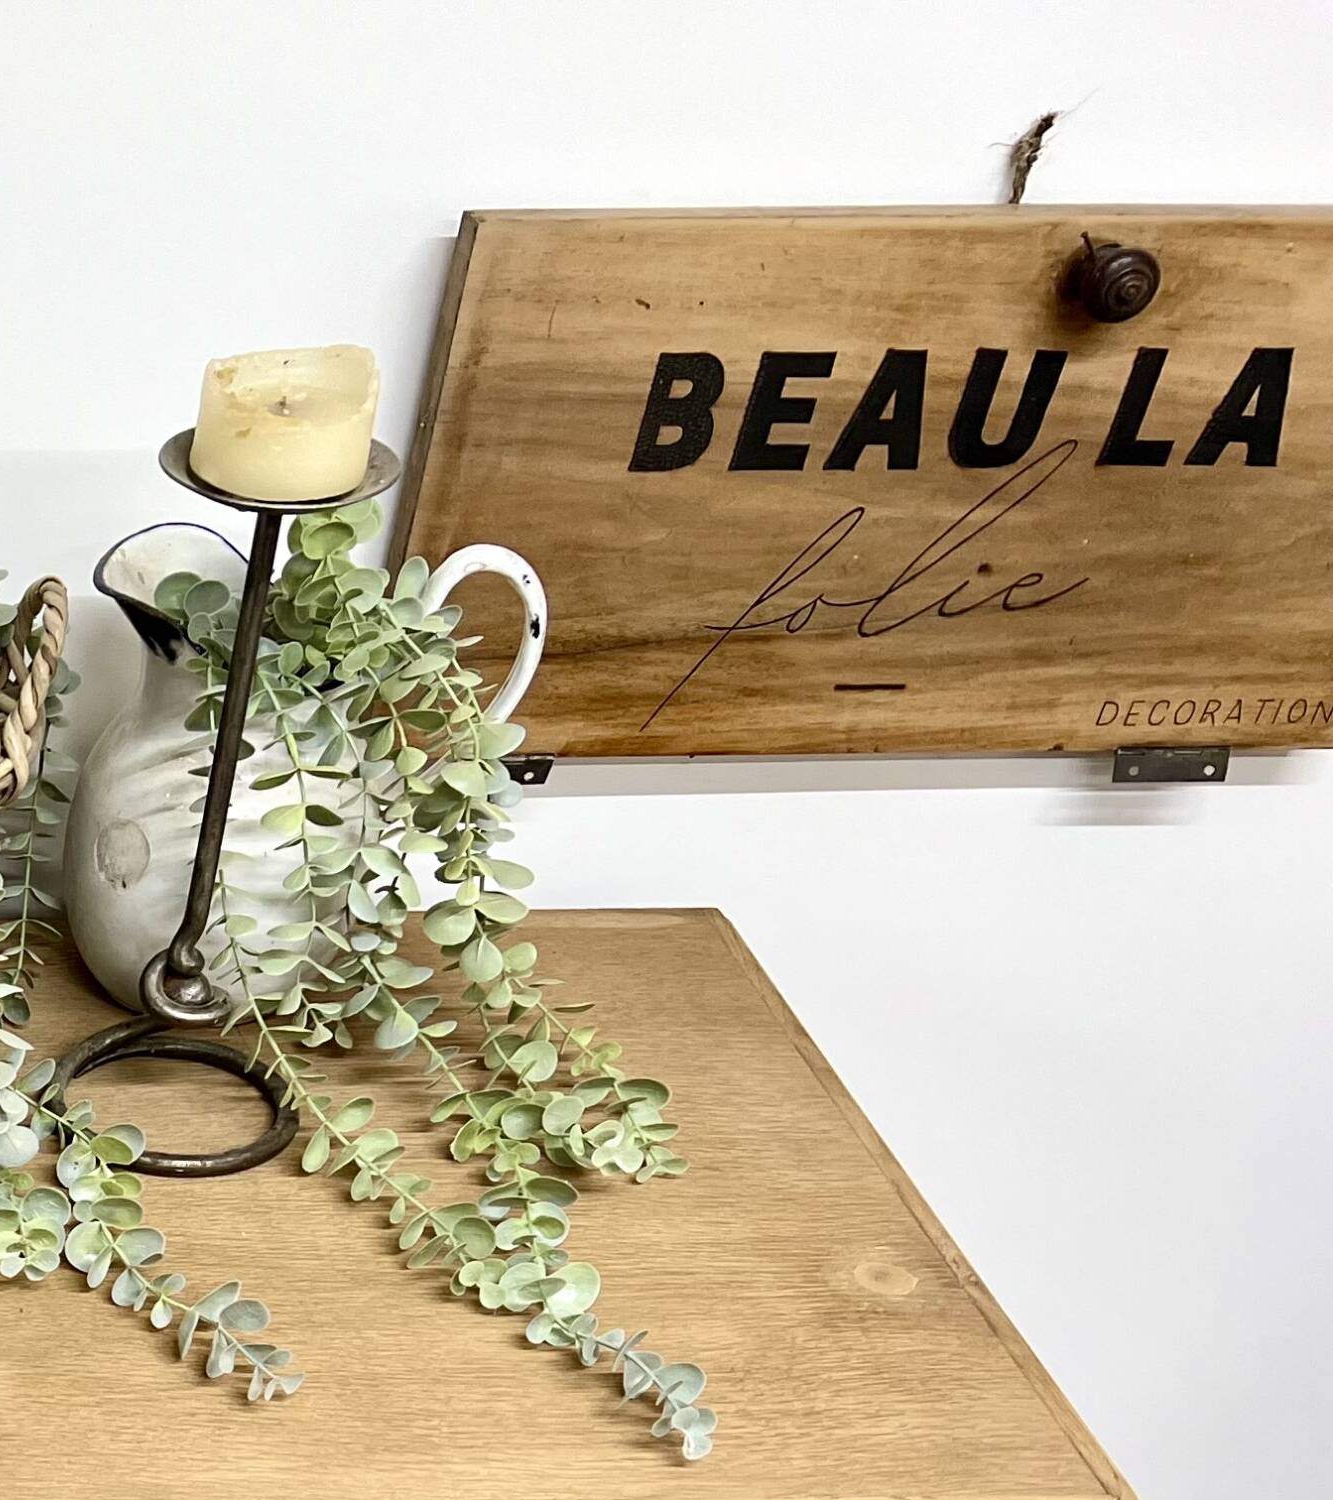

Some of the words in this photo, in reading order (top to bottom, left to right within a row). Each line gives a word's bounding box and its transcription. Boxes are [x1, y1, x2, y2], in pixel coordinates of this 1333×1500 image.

[627, 349, 1069, 473] BEAU
[1095, 347, 1295, 468] LA
[639, 439, 1091, 733] folie
